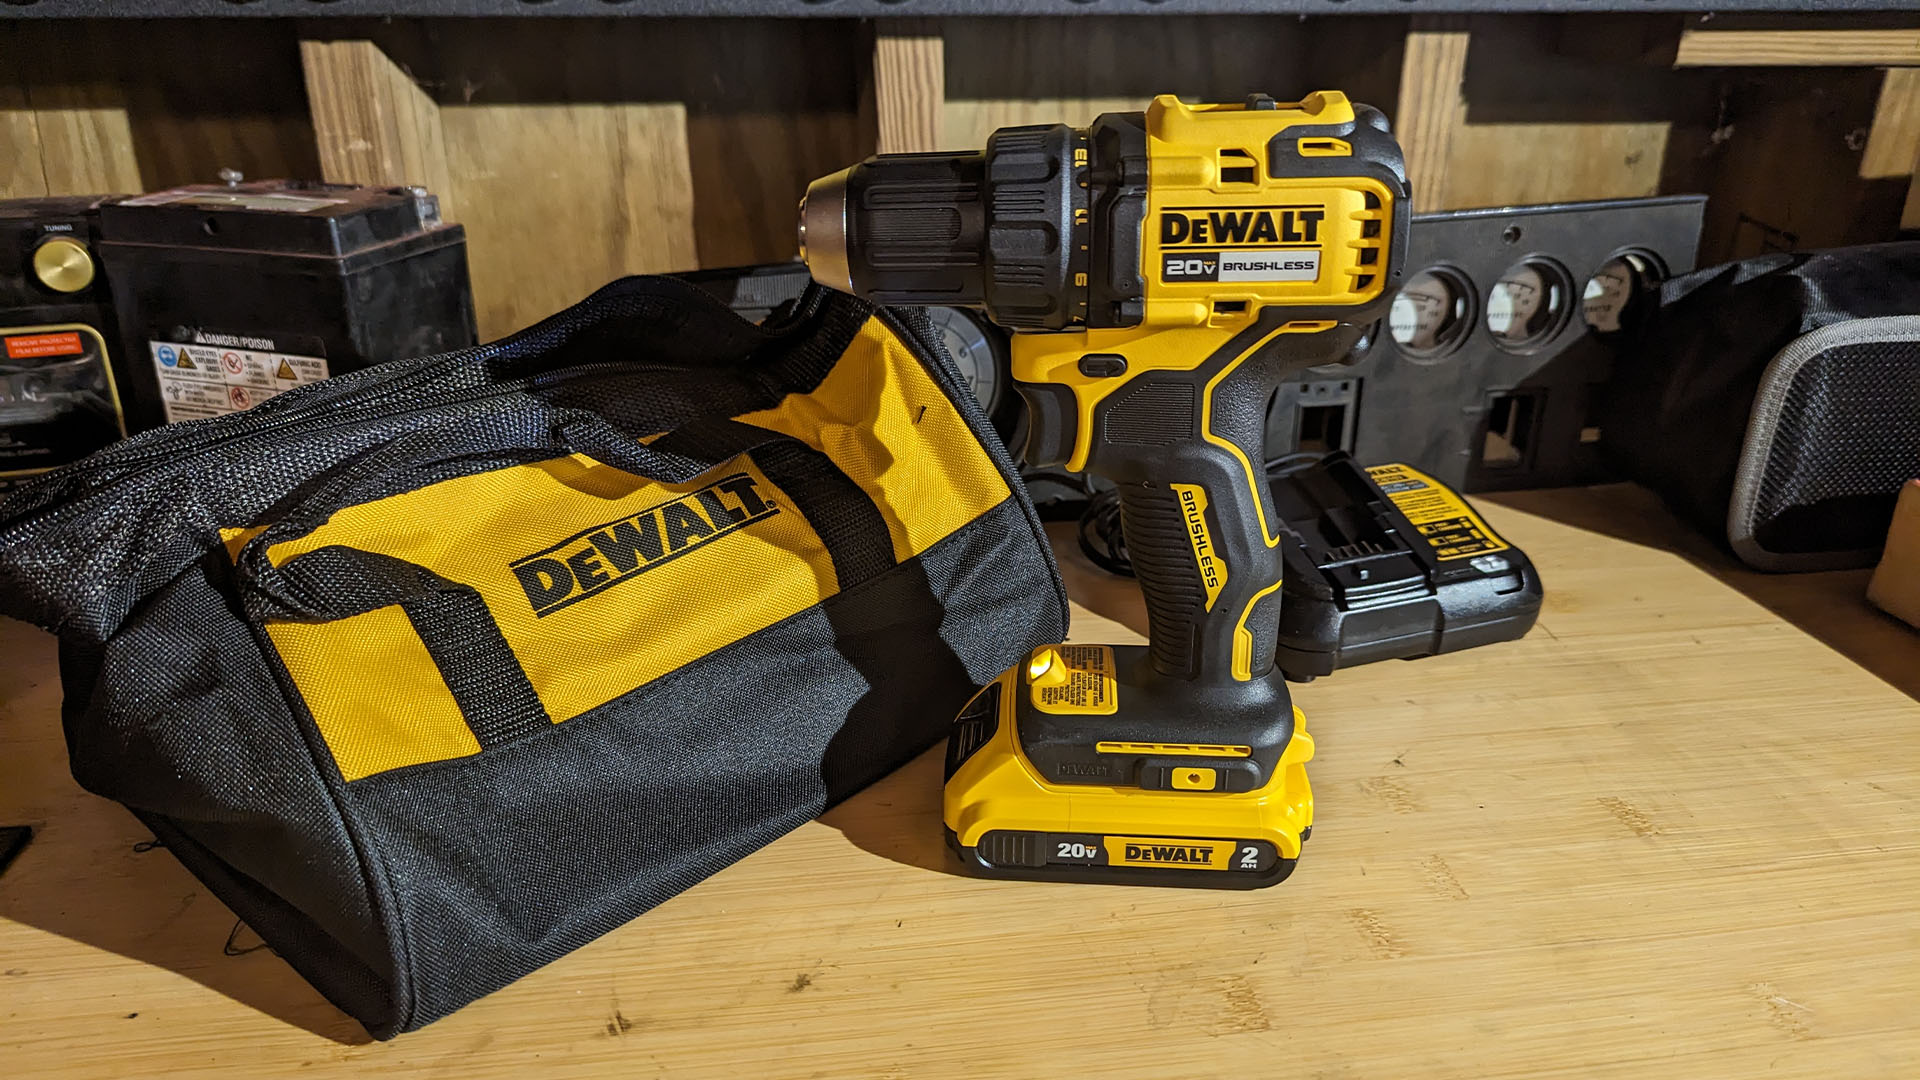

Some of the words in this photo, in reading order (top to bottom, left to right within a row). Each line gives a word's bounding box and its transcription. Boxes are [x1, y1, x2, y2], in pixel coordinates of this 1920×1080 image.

[1074, 148, 1088, 168] 13
[1074, 208, 1088, 226] 11
[1223, 261, 1315, 272] BRUSHLESS
[204, 333, 275, 350] DANGER/POISON
[1182, 490, 1219, 589] BRUSHLESS
[1240, 846, 1259, 864] 2
